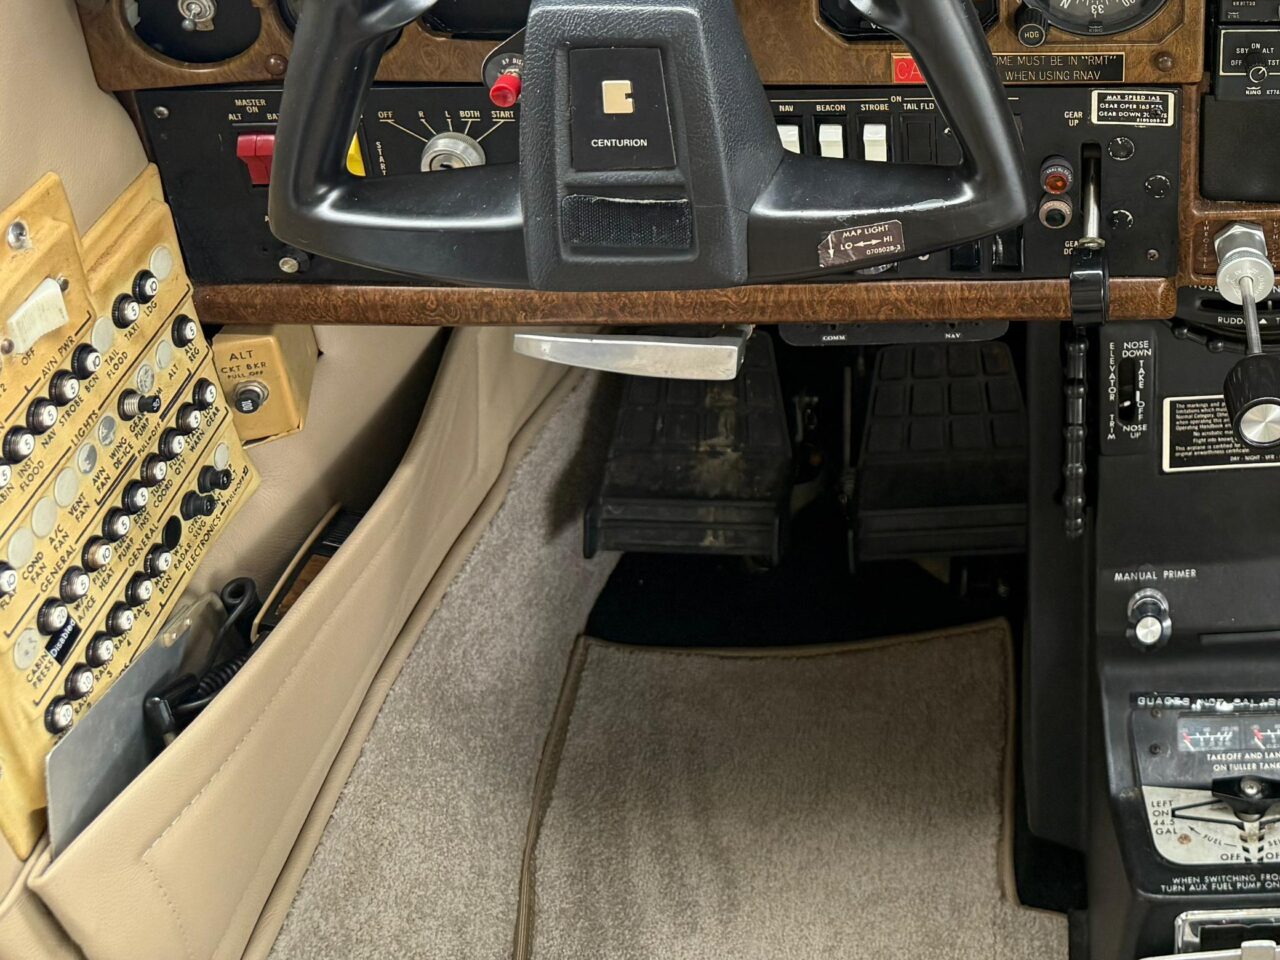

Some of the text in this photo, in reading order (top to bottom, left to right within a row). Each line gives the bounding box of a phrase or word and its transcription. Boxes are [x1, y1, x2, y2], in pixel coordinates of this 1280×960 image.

[1005, 71, 1100, 81] WHEN USING RNAV
[816, 104, 846, 112] BEACON
[861, 104, 889, 112] STROBE
[903, 103, 918, 111] TAIL
[920, 103, 935, 111] FLD
[229, 113, 242, 121] ALT
[445, 110, 450, 118] L
[459, 110, 480, 118] BOTH
[491, 110, 514, 118] START
[1069, 119, 1079, 127] UP
[591, 139, 648, 147] CENTURION
[842, 224, 889, 238] MAP LIGHT
[144, 300, 157, 317] LDG
[124, 324, 140, 341] TAXI
[1124, 341, 1149, 349] NOSE
[21, 347, 35, 366] OFF
[41, 336, 75, 379] AVN PWR
[229, 350, 254, 361] ALT
[1122, 349, 1151, 358] DOWN
[220, 361, 267, 374] CKT BKR
[1107, 342, 1117, 439] ELEVATOR TRIM
[59, 395, 84, 427] STROBE
[70, 410, 99, 447] LIGHTS
[1123, 424, 1147, 432] NOSE
[41, 428, 56, 448] NAV
[1130, 431, 1141, 439] UP
[109, 436, 127, 459] WING
[113, 443, 133, 470] DE-ICE
[67, 492, 86, 517] VENT
[74, 502, 91, 523] FAN
[127, 523, 159, 567] GENERAL
[185, 514, 222, 572] ELECTRONICS
[40, 543, 77, 593] GENERAL
[1114, 569, 1197, 581] MANUAL PRIMER
[50, 619, 76, 658] Disabled
[26, 651, 48, 683] CABIN
[33, 659, 53, 690] PRESS
[1207, 753, 1242, 761] TAKEOFF
[1151, 800, 1174, 808] LEFT
[1152, 809, 1169, 817] ON
[1153, 819, 1175, 827] 44.5
[1155, 828, 1178, 836] GAL
[1202, 834, 1222, 846] FUEL
[1220, 853, 1241, 861] OFF
[1172, 876, 1201, 884] WHEN
[1204, 873, 1256, 883] SWITCHING
[1211, 882, 1233, 890] FUEL
[1236, 881, 1261, 889] PUMP
